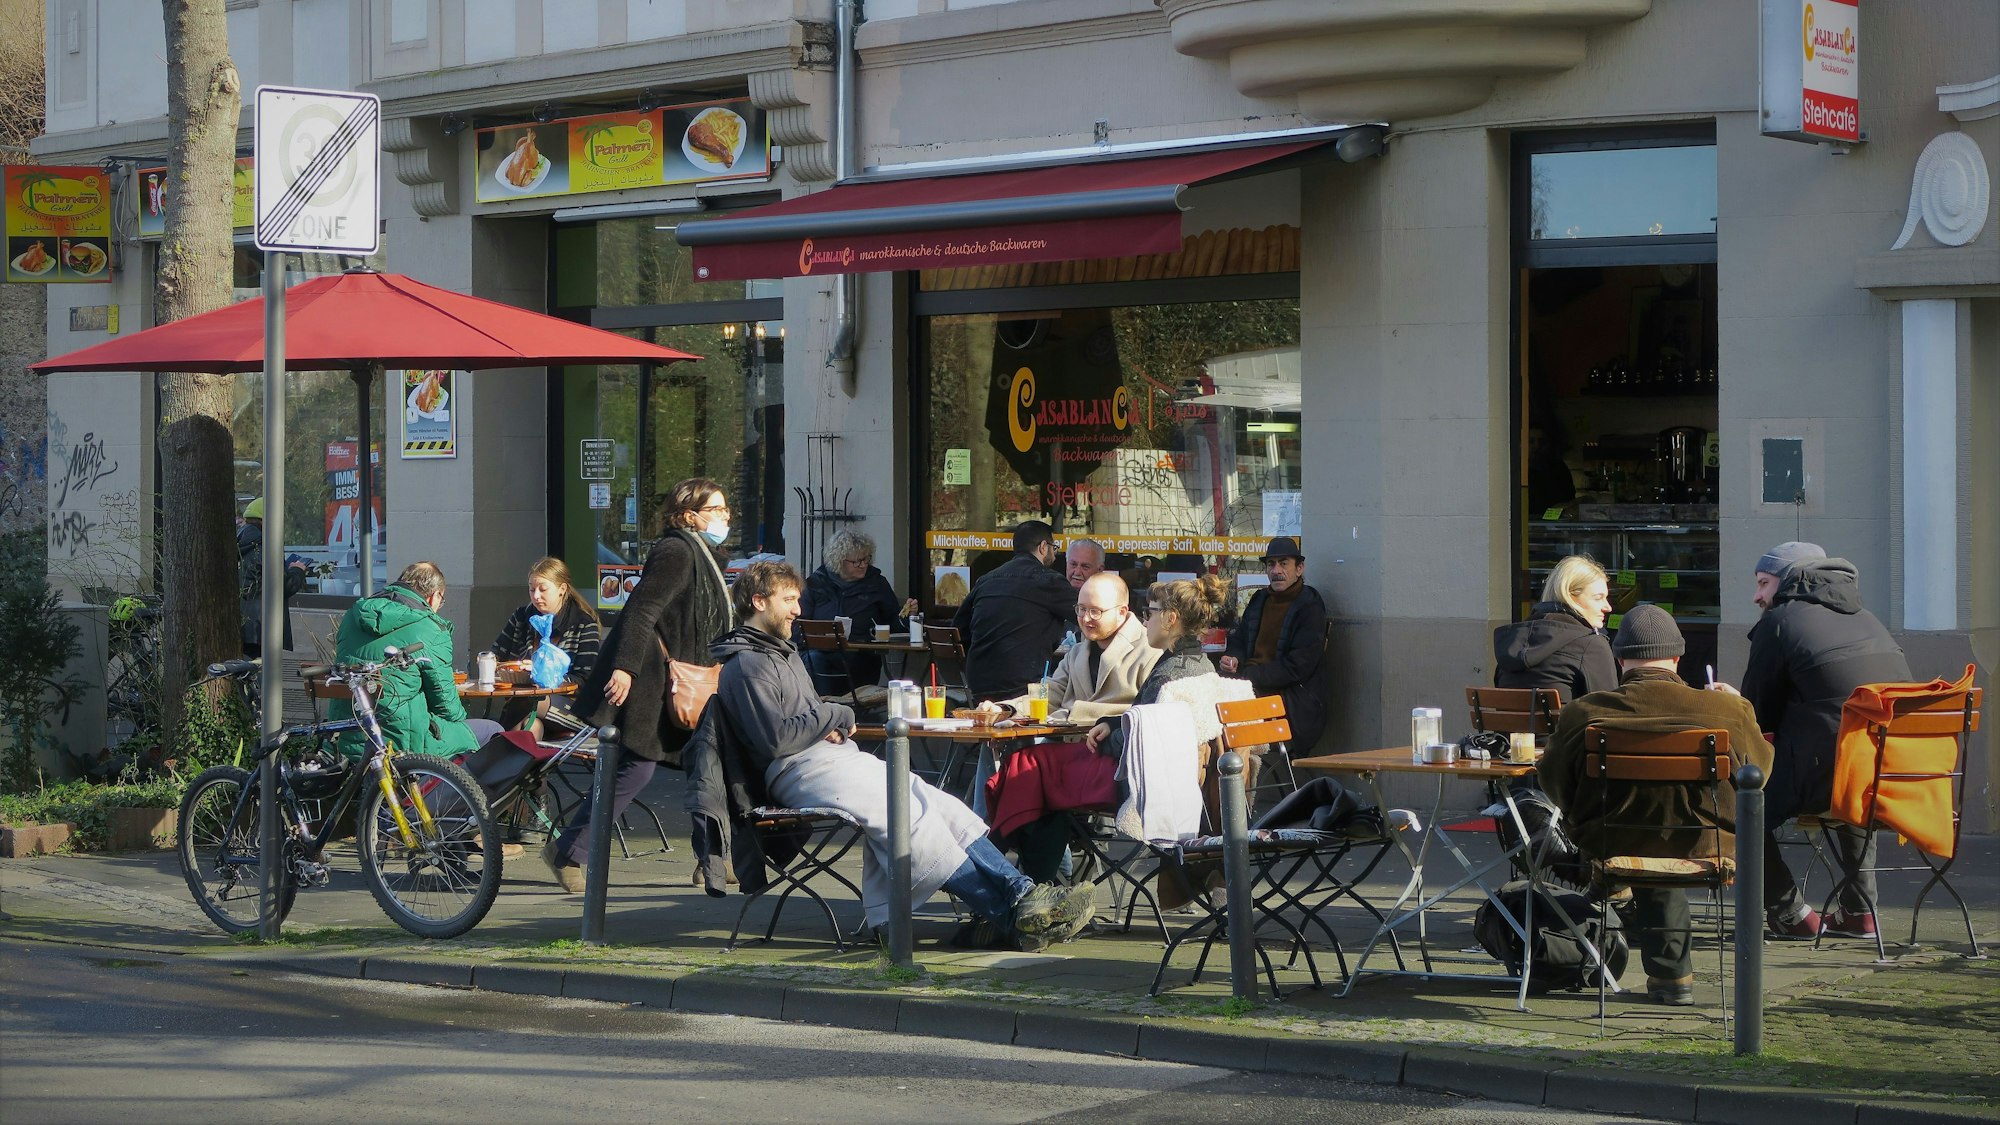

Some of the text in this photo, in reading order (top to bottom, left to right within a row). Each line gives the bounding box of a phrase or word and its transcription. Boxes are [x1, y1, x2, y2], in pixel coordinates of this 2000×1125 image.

[1804, 98, 1856, 132] Stehcafé
[595, 142, 651, 156] Palmen
[608, 154, 628, 164] Grill
[34, 193, 98, 204] Palmen
[51, 204, 73, 212] Grill
[288, 214, 347, 240] ZONE
[800, 238, 1047, 275] CASABLANCA marokkanische & deutsche Backwaren
[1008, 366, 1141, 453] CASABLANCA
[1039, 434, 1094, 444] marokkanische
[1099, 433, 1132, 444] deutsche
[1054, 446, 1125, 462] Backwaren
[1046, 479, 1132, 507] Stehcafé
[933, 534, 989, 549] Milchkaffee,
[1117, 538, 1171, 553] gepresster
[1173, 538, 1196, 553] Saft,
[1199, 539, 1224, 552] kalte
